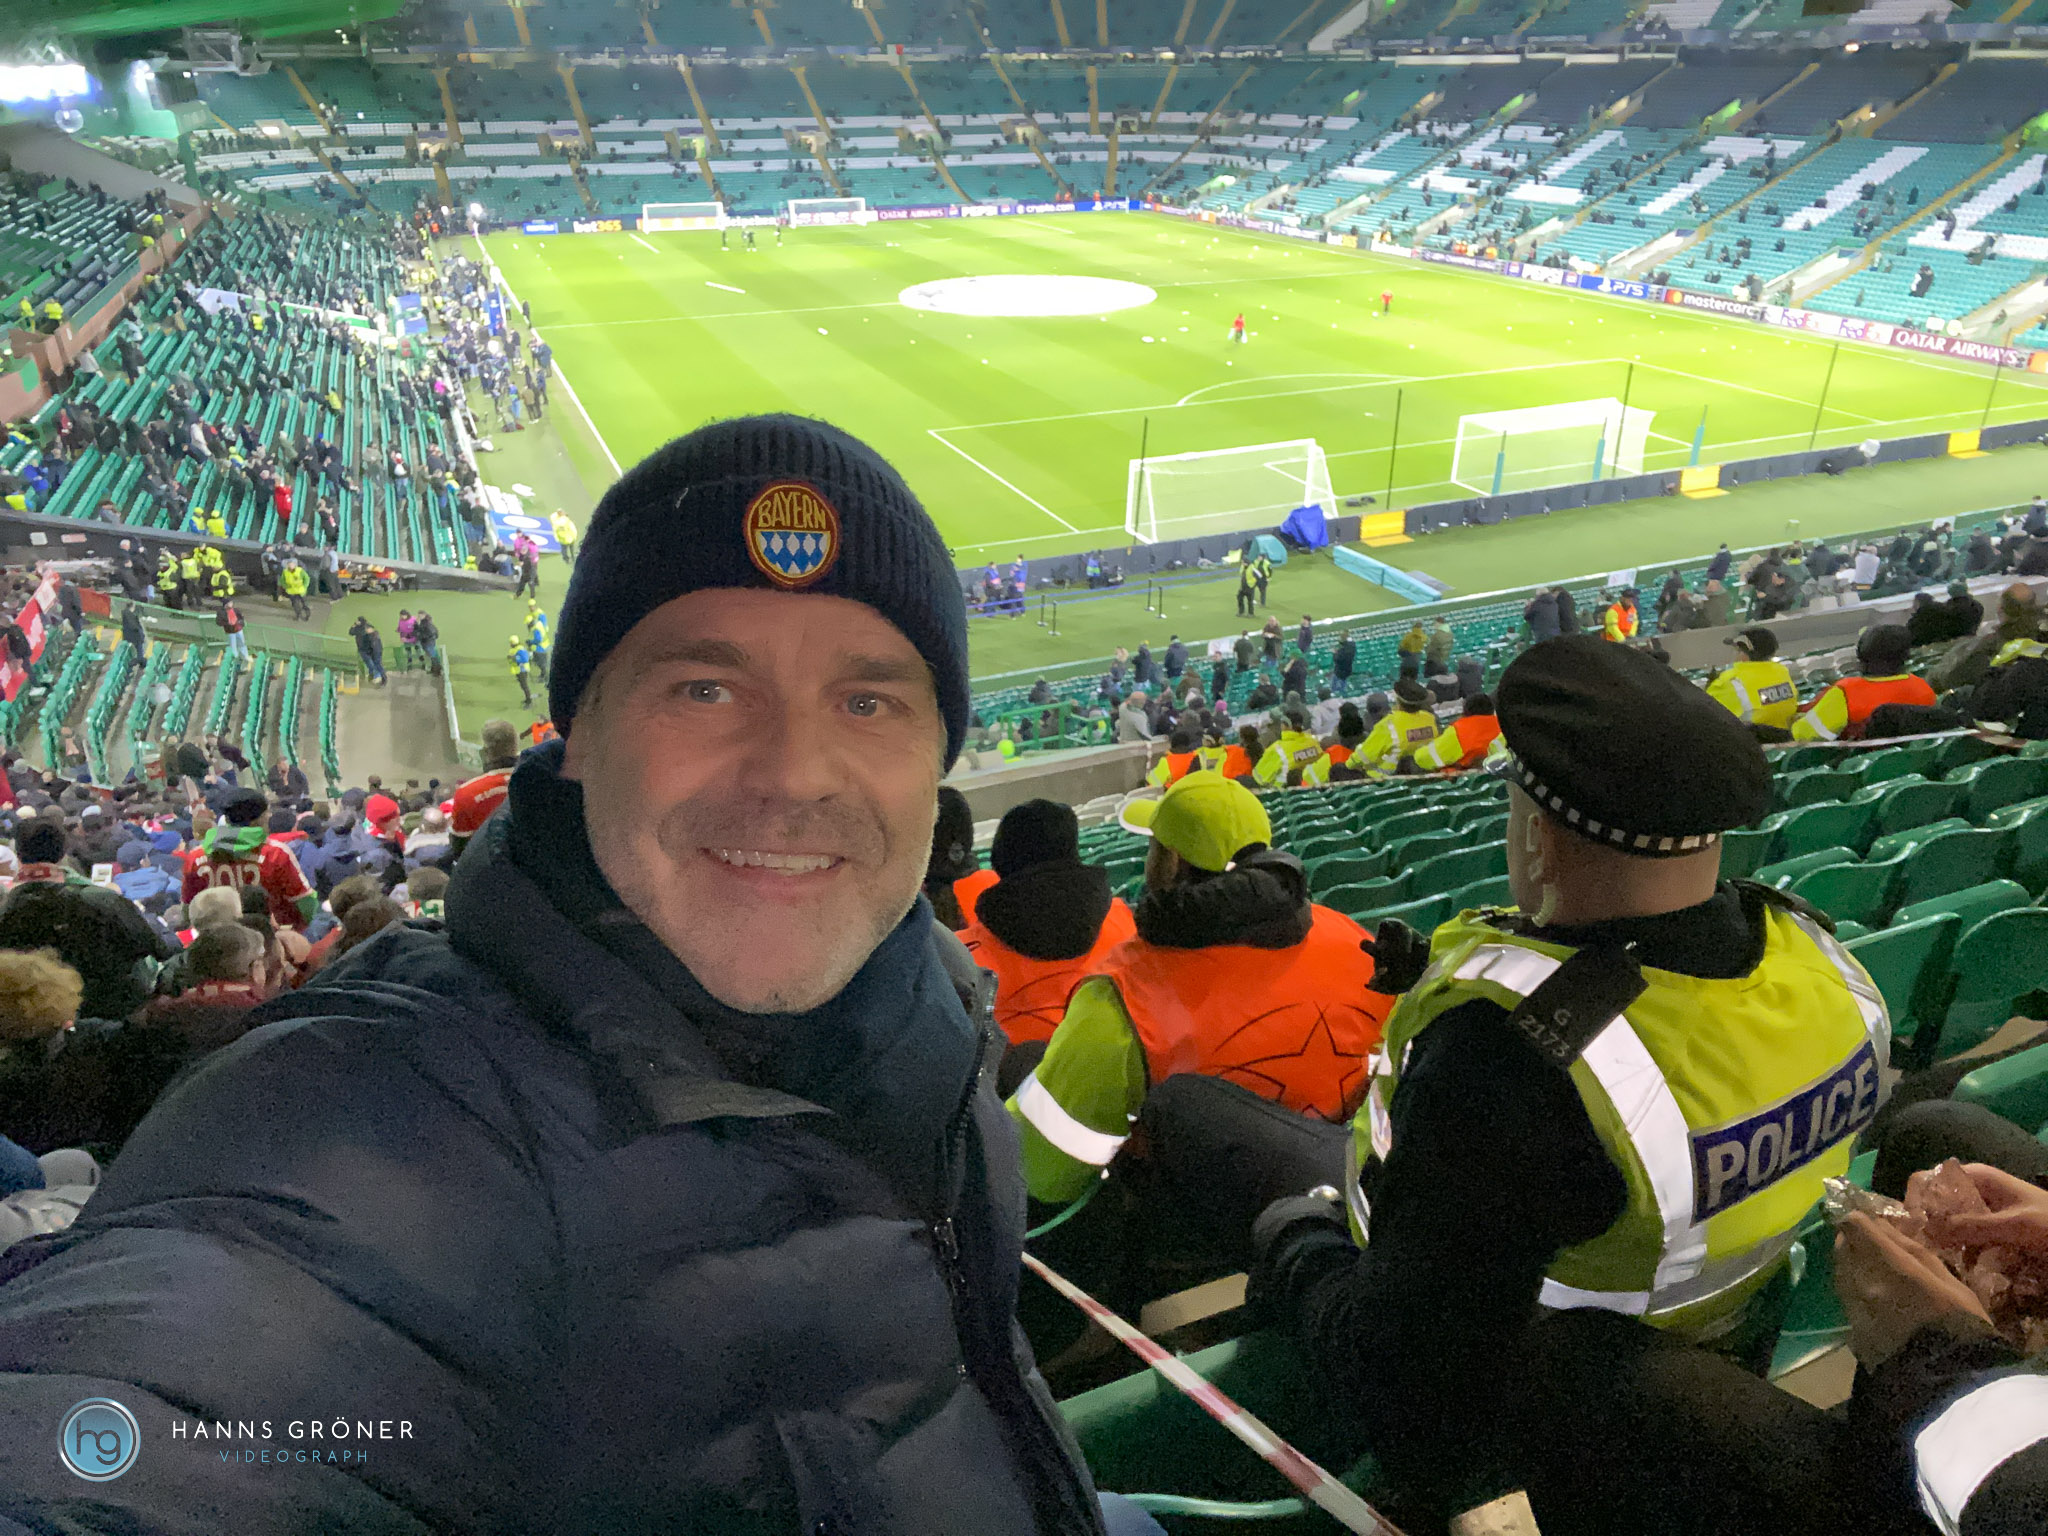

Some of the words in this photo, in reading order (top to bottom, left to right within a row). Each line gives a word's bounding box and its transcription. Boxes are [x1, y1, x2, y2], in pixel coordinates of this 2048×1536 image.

[573, 220, 622, 232] bet365
[1612, 283, 1645, 297] PS5
[1895, 330, 1946, 352] QATAR
[1950, 341, 2018, 366] AIRWAYS
[758, 491, 827, 529] BAYERN
[1706, 1057, 1876, 1211] POLICE
